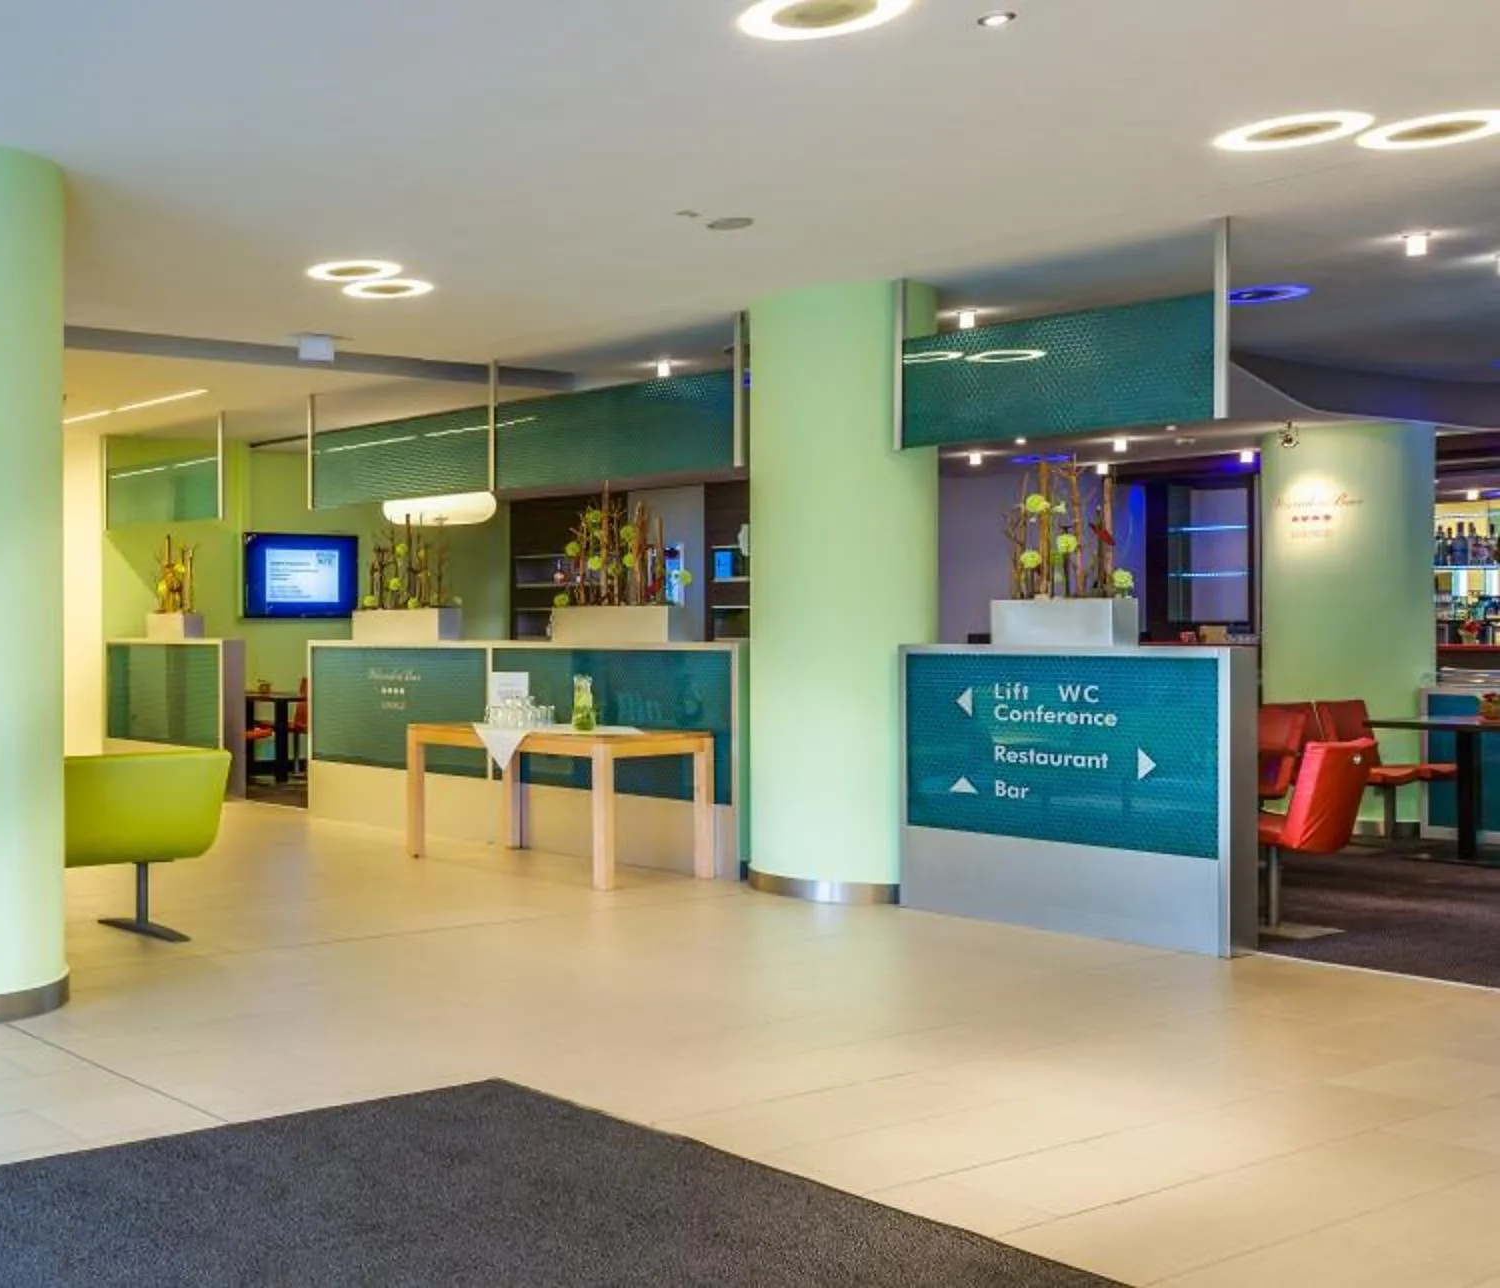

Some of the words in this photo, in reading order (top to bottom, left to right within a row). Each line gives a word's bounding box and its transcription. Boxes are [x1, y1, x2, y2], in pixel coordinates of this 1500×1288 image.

[995, 682, 1029, 700] Lift
[1057, 685, 1100, 703] WC
[994, 703, 1118, 727] Conference
[994, 745, 1109, 769] Restaurant
[995, 780, 1030, 799] Bar
